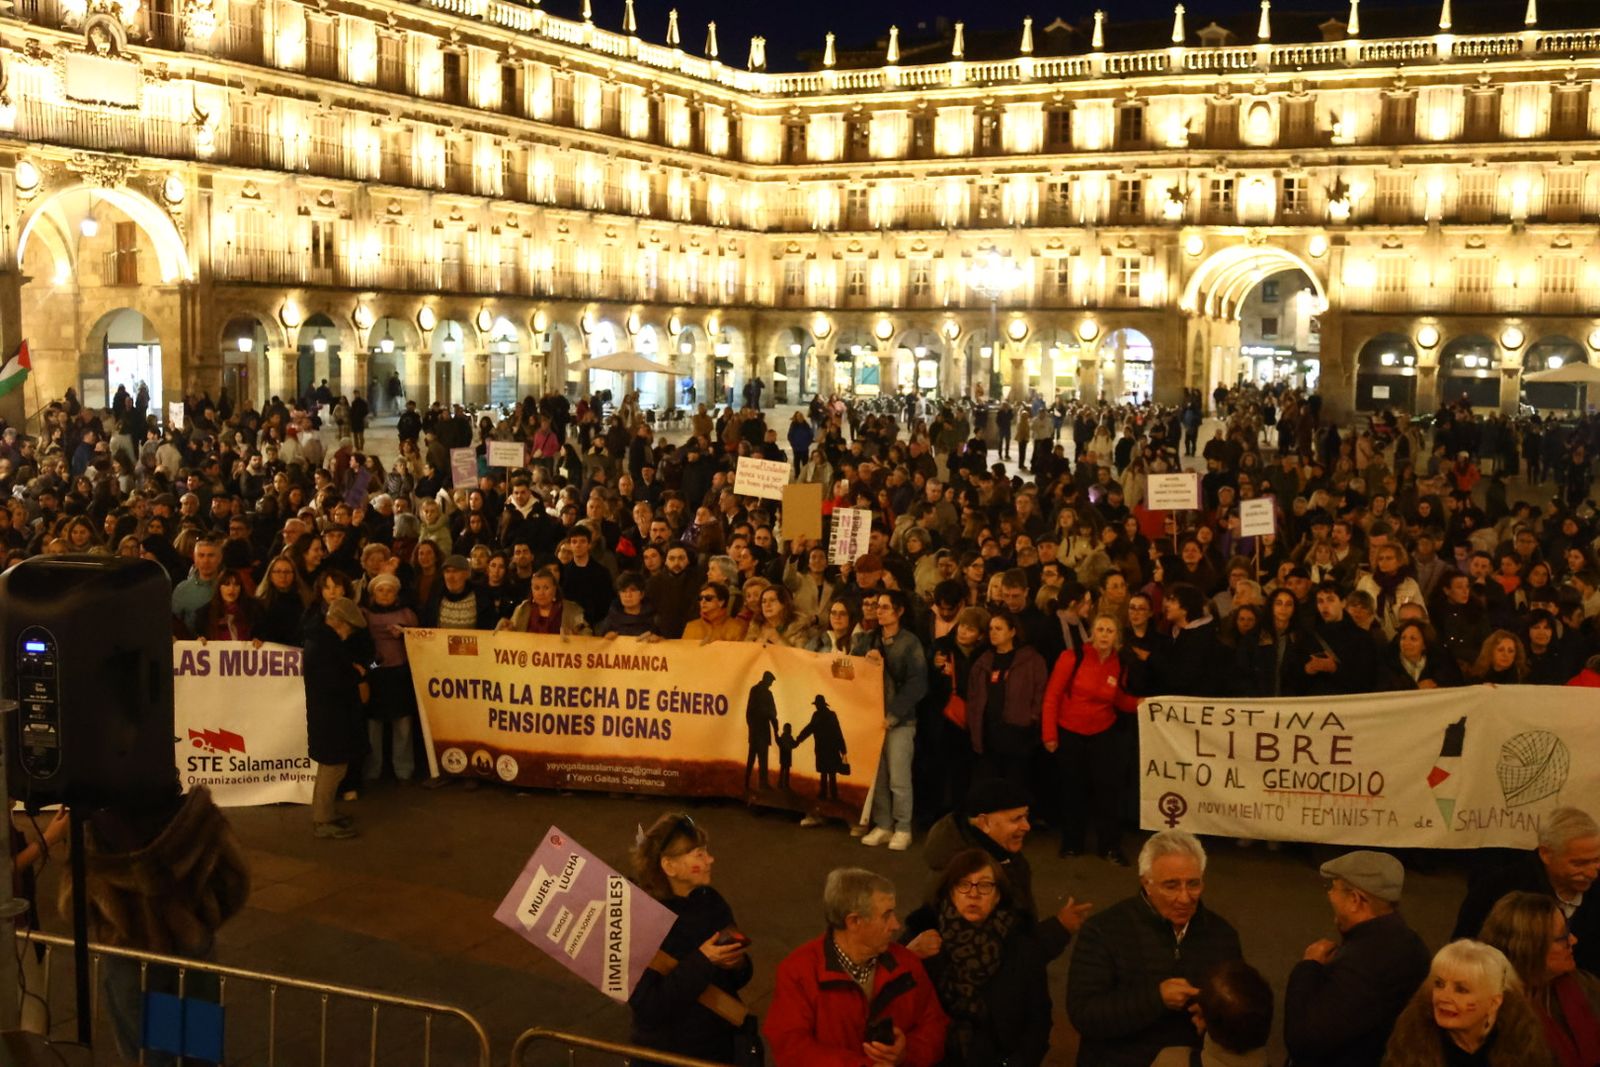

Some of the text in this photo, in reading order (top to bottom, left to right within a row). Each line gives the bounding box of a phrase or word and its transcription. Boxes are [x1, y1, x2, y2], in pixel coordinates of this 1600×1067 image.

[219, 650, 304, 677] MUJER
[494, 648, 669, 672] YAY@ GAITAS SALAMANCA
[428, 677, 729, 716] CONTRA LA BRECHA DE GÉNERO
[488, 707, 672, 741] PENSIONES DIGNAS
[1148, 702, 1346, 731] PALESTINA
[1195, 719, 1354, 766] LIBRE
[187, 755, 312, 773] STE Salamanca
[187, 775, 260, 785] Organización
[263, 773, 277, 783] de
[1146, 759, 1385, 797] ALTO AL GENOCIDIO
[622, 775, 666, 787] Salamanca
[1198, 801, 1541, 833] MOVIMIENTO FEMINISTA de SALAMAN
[559, 854, 579, 890] LUCHA
[528, 878, 555, 917] MUJER,
[552, 910, 570, 938] PORQUE
[581, 906, 597, 931] SOMOS
[608, 875, 623, 992] ¡IMPARABLES!
